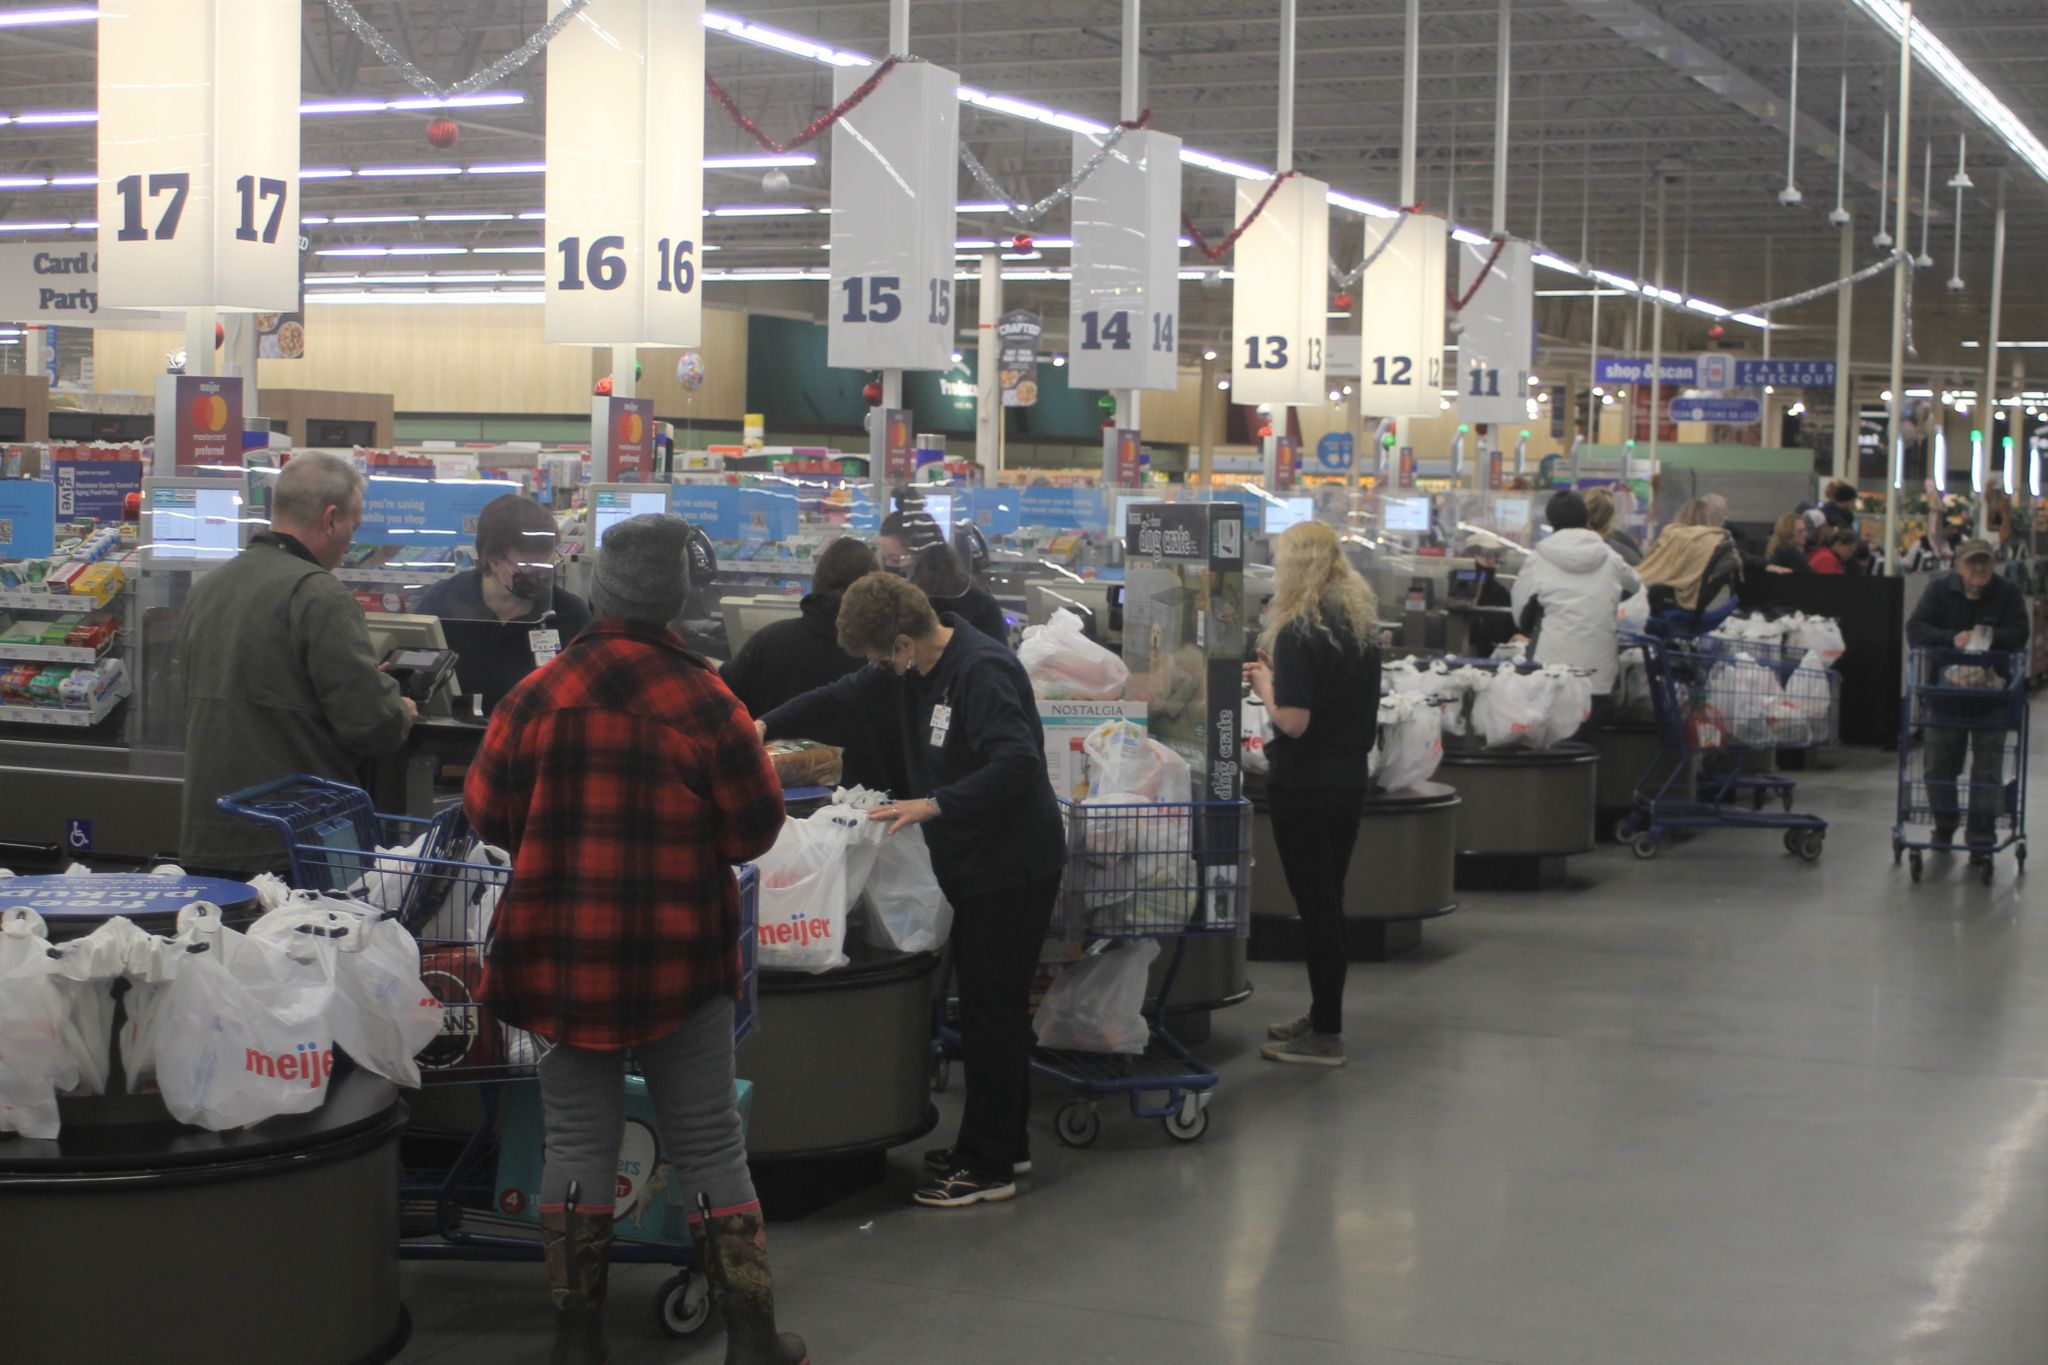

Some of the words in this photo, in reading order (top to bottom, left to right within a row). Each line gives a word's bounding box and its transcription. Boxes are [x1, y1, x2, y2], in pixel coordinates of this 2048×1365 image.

[117, 173, 189, 241] 17
[236, 175, 287, 244] 17
[34, 252, 89, 274] Card
[558, 235, 627, 290] 16
[657, 238, 694, 294] 16
[39, 288, 97, 313] Party
[842, 277, 902, 323] 15
[929, 278, 950, 325] 15
[1081, 311, 1131, 350] 14
[1152, 312, 1174, 352] 14
[1245, 336, 1288, 369] 13
[1308, 337, 1322, 371] 13
[1744, 363, 1834, 373] FASTER
[1372, 356, 1412, 385] 12
[1429, 357, 1440, 387] 12
[1469, 369, 1500, 396] 11
[1605, 362, 1641, 381] shop
[1658, 366, 1693, 379] scan
[1744, 374, 1834, 384] CHECKOUT
[194, 445, 225, 458] preferred
[59, 477, 74, 511] give
[1139, 520, 1161, 562] dog
[1163, 525, 1191, 554] crate
[1051, 705, 1124, 717] NOSTALGIA
[1216, 709, 1233, 759] crate
[1214, 760, 1237, 800] dog
[0, 889, 199, 900] pickup
[29, 900, 147, 909] free
[759, 913, 831, 946] meijer
[440, 1015, 475, 1031] ANS
[246, 1042, 334, 1089] meije
[616, 1159, 641, 1176] ers
[505, 1191, 518, 1207] 4
